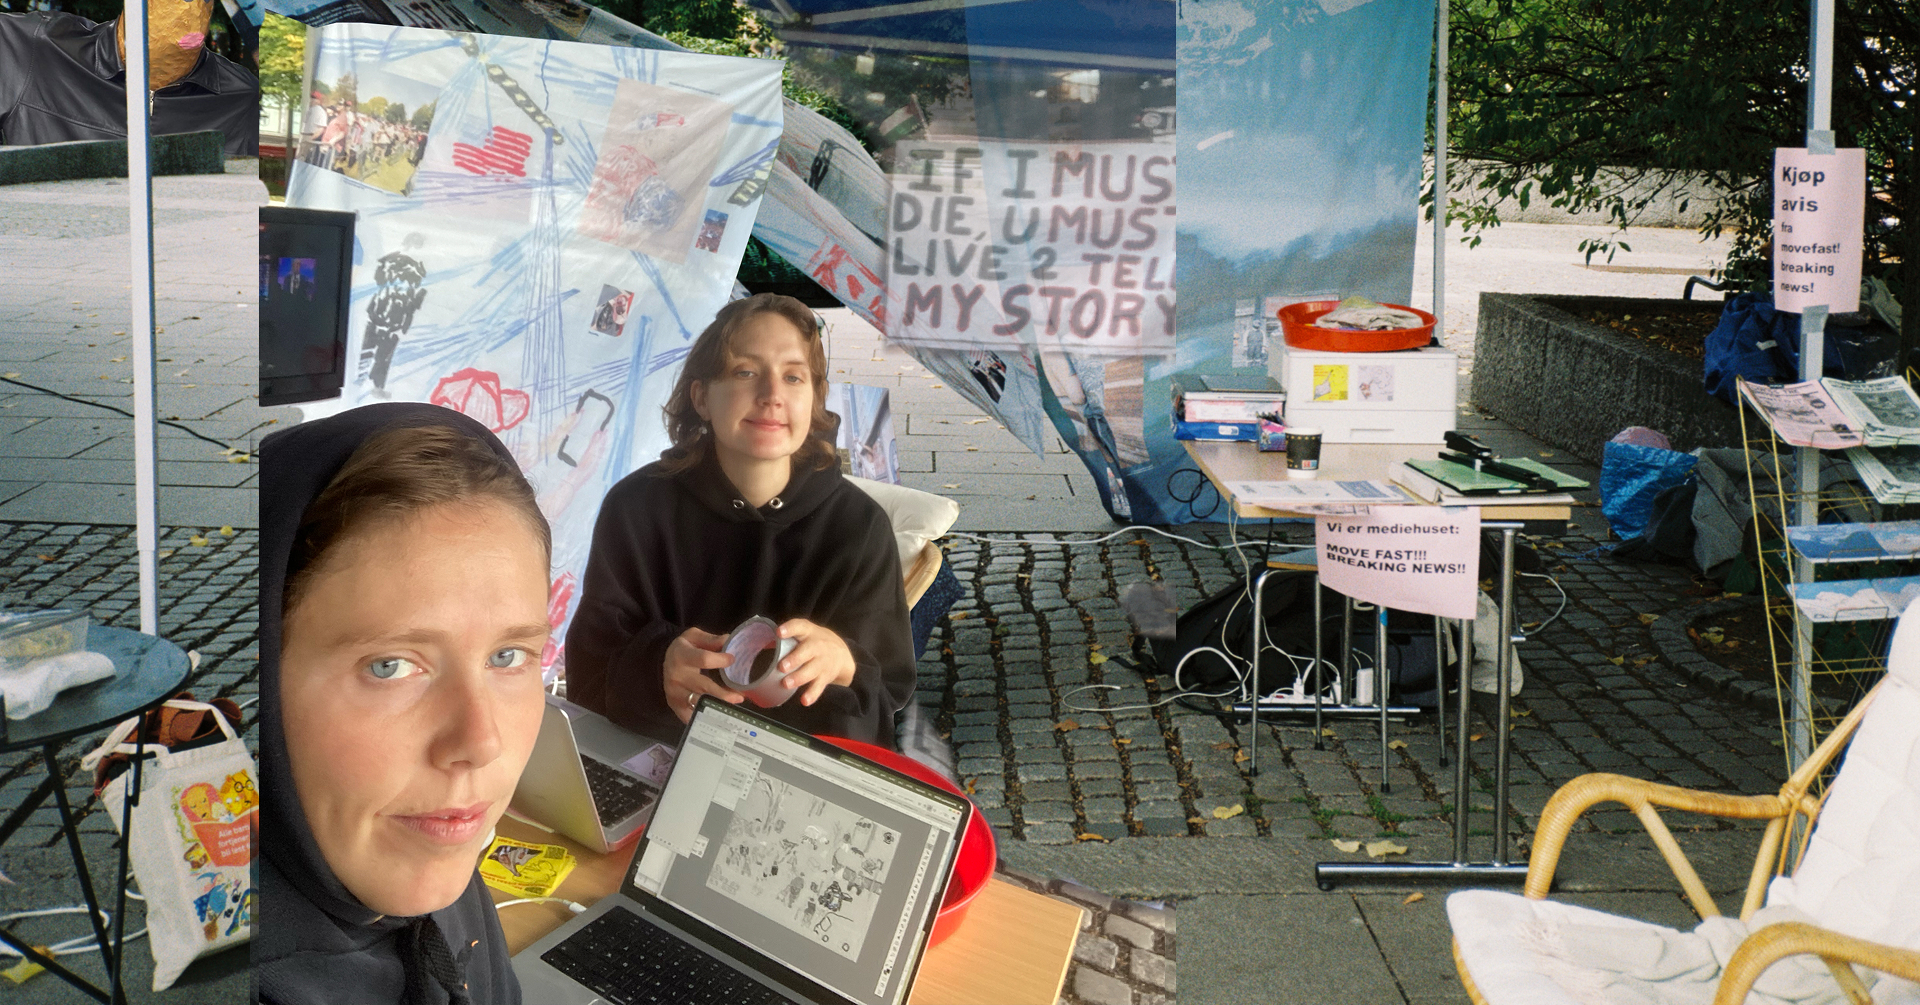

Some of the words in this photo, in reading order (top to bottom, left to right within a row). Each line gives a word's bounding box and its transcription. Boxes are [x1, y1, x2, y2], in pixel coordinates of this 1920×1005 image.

[909, 147, 984, 194] IF
[1001, 149, 1038, 199] I
[1052, 150, 1176, 204] MUS
[1782, 166, 1826, 187] Kjøp
[1781, 196, 1819, 212] avis
[892, 192, 986, 242] DIE,
[1002, 205, 1040, 245] U
[1781, 222, 1793, 234] fra
[1781, 243, 1841, 254] movefast!
[892, 237, 1009, 281] LIVE
[1030, 246, 1058, 280] 2
[1780, 261, 1835, 276] breaking
[1780, 282, 1815, 293] news!
[902, 282, 985, 332] MY
[992, 283, 1176, 339] STORY
[1326, 522, 1342, 533] Vi
[1346, 525, 1363, 534] er
[1367, 523, 1460, 535] mediehuset:
[1326, 543, 1370, 558] MOVE
[1375, 550, 1427, 561] FAST!!!
[1326, 552, 1407, 573] BREAKING
[1412, 563, 1466, 574] NEWS!!
